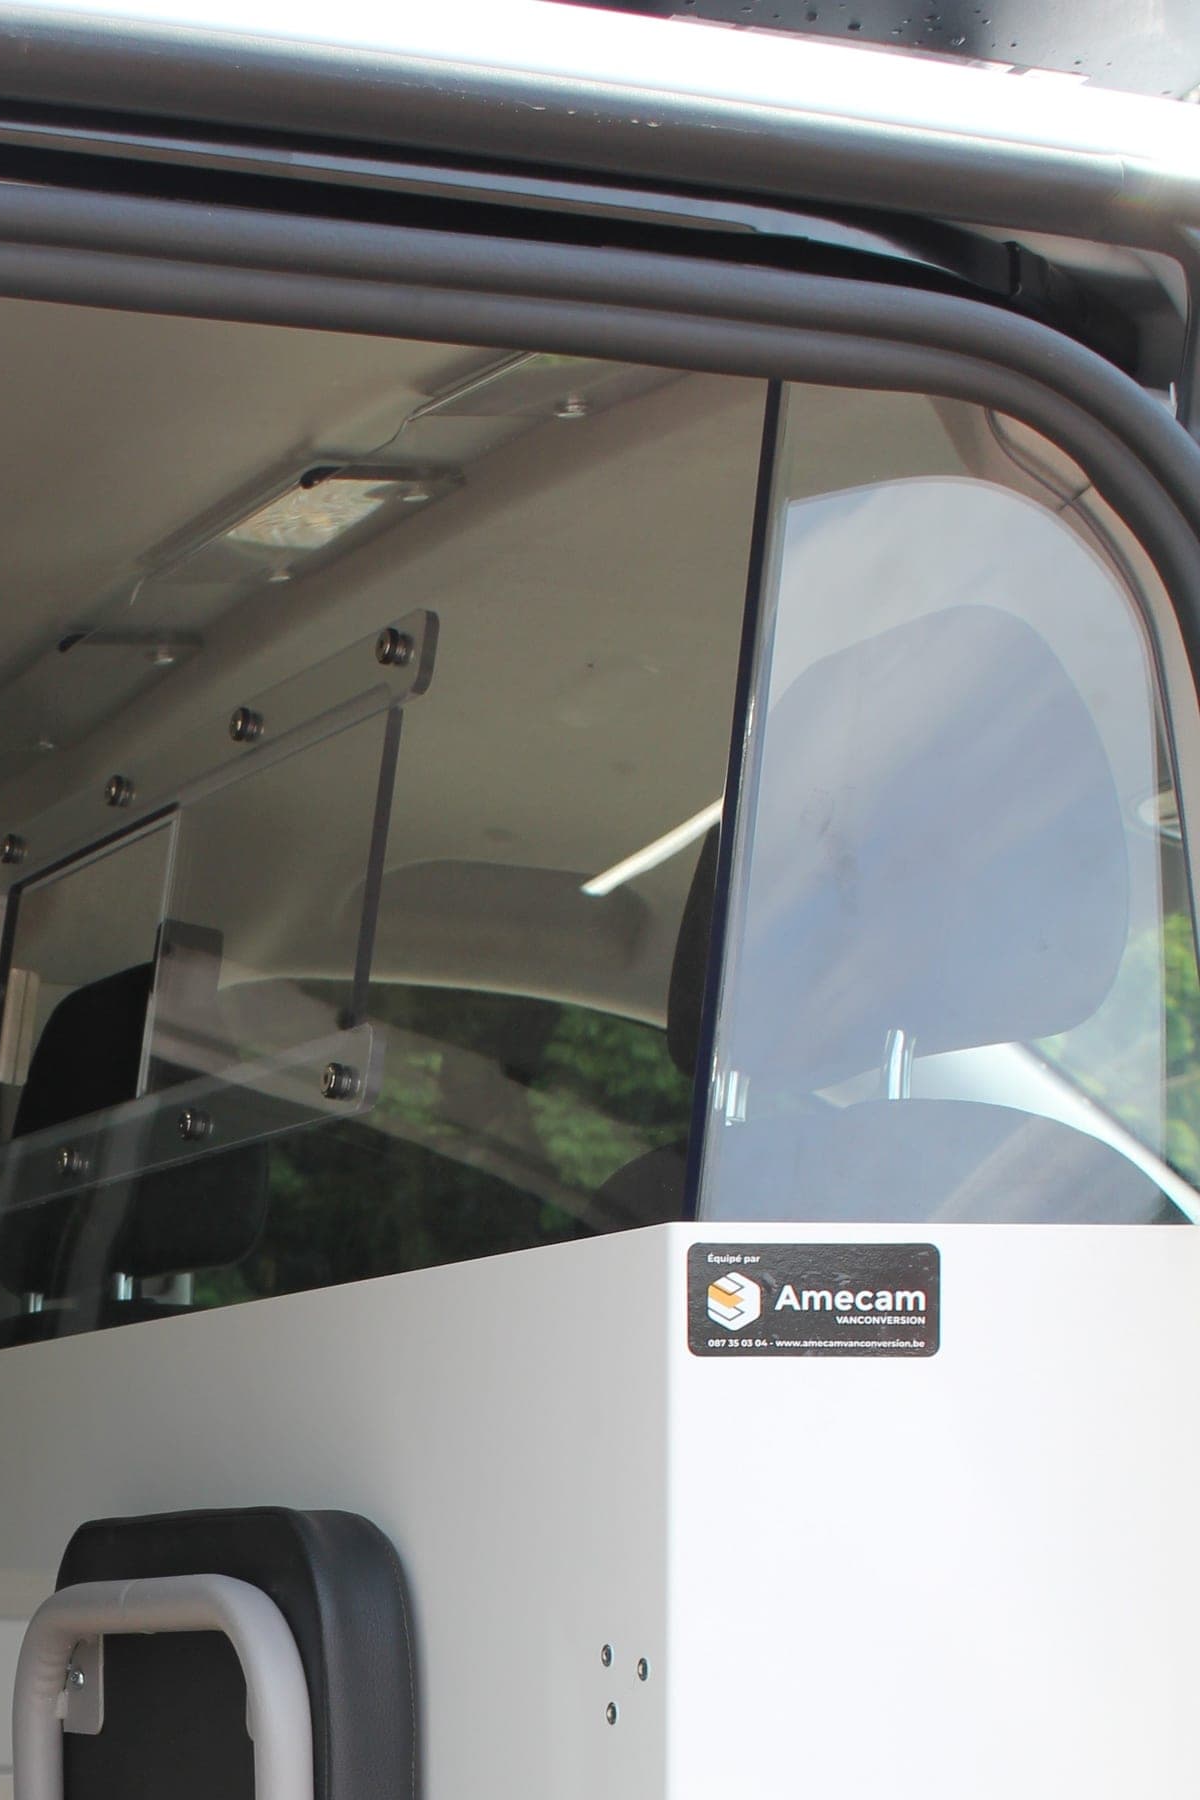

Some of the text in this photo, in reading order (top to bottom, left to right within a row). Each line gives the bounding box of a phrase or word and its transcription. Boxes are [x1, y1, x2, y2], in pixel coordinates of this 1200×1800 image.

[707, 1253, 760, 1264] Équipé par
[775, 1286, 925, 1310] Amecam
[836, 1315, 925, 1325] VANCONVERSION
[708, 1339, 726, 1348] 087
[728, 1339, 739, 1348] 35
[742, 1339, 753, 1348] 03
[755, 1339, 768, 1348] 04
[776, 1338, 925, 1349] www.amecamvanconversion.be
